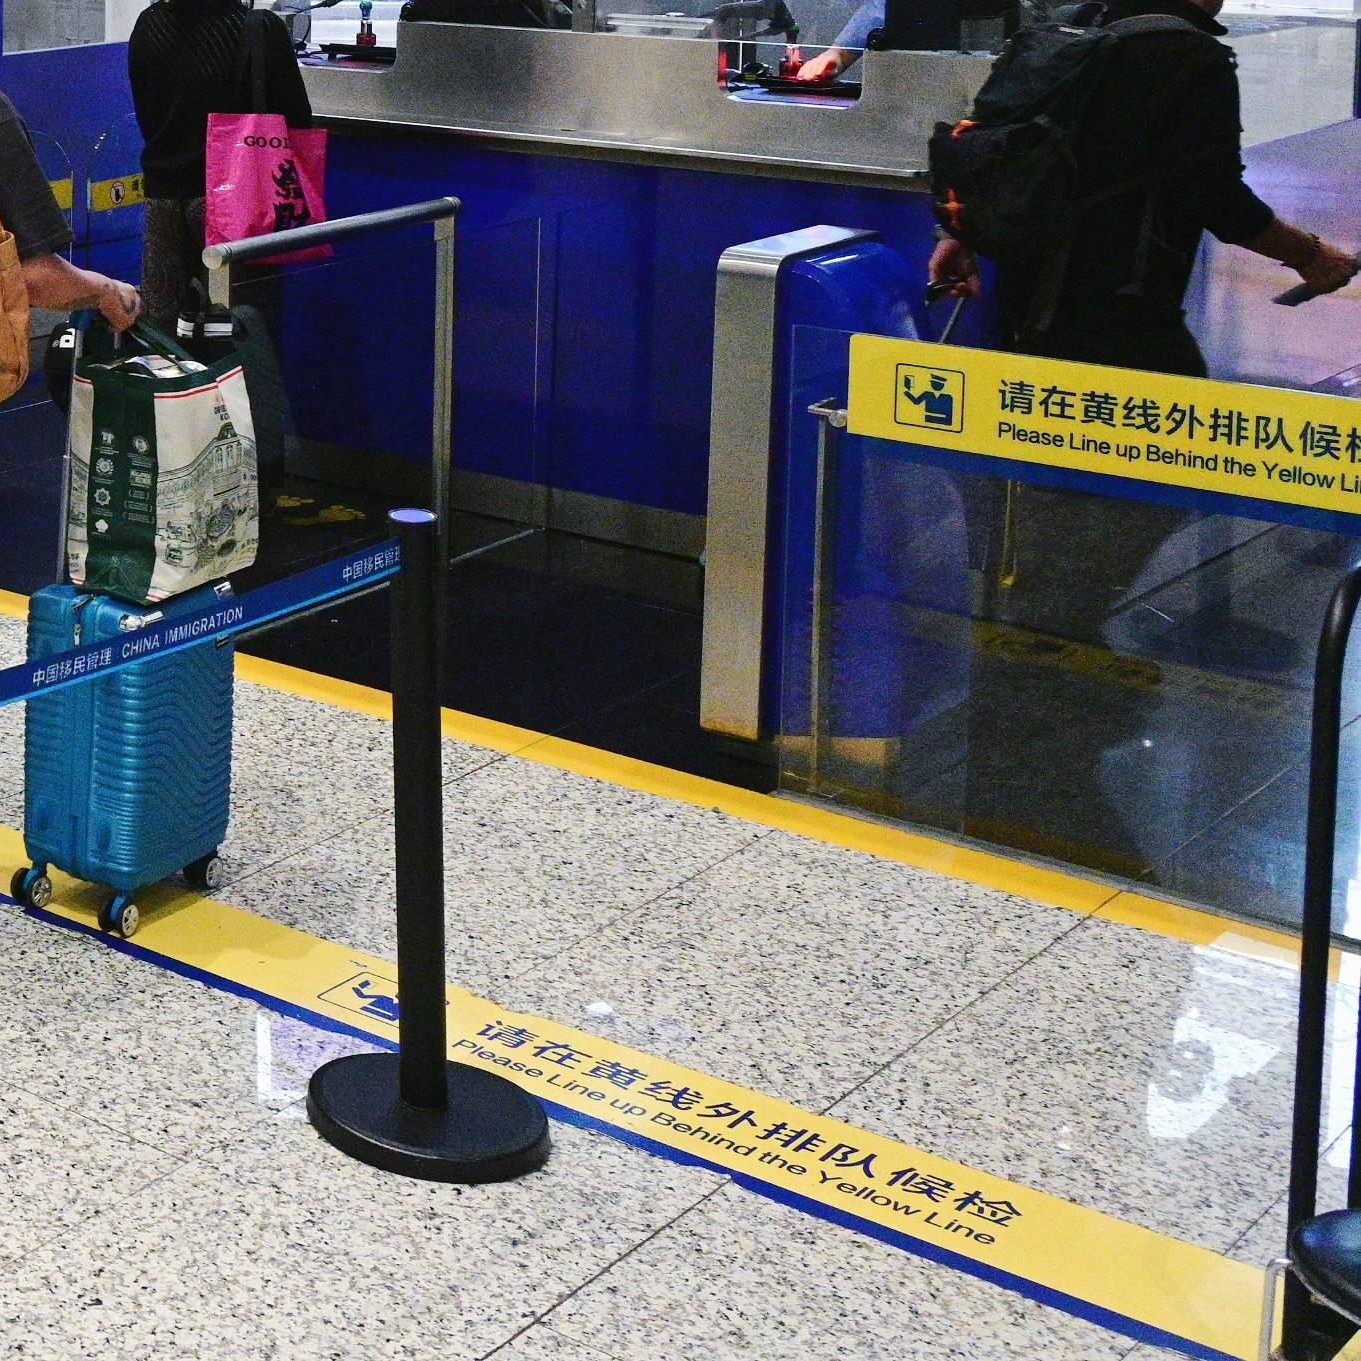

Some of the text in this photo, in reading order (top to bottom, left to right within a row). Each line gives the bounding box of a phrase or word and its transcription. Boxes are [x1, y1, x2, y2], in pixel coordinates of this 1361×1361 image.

[998, 421, 1361, 493] Please Line up Behind the Yellow Li
[33, 646, 113, 687] 中国移民管理
[122, 606, 244, 660] CHINA IMMIGRATION
[450, 1038, 998, 1247] Please Line up Behind the Yellow Line
[475, 1019, 1024, 1230] 请在黄线外排队候检
